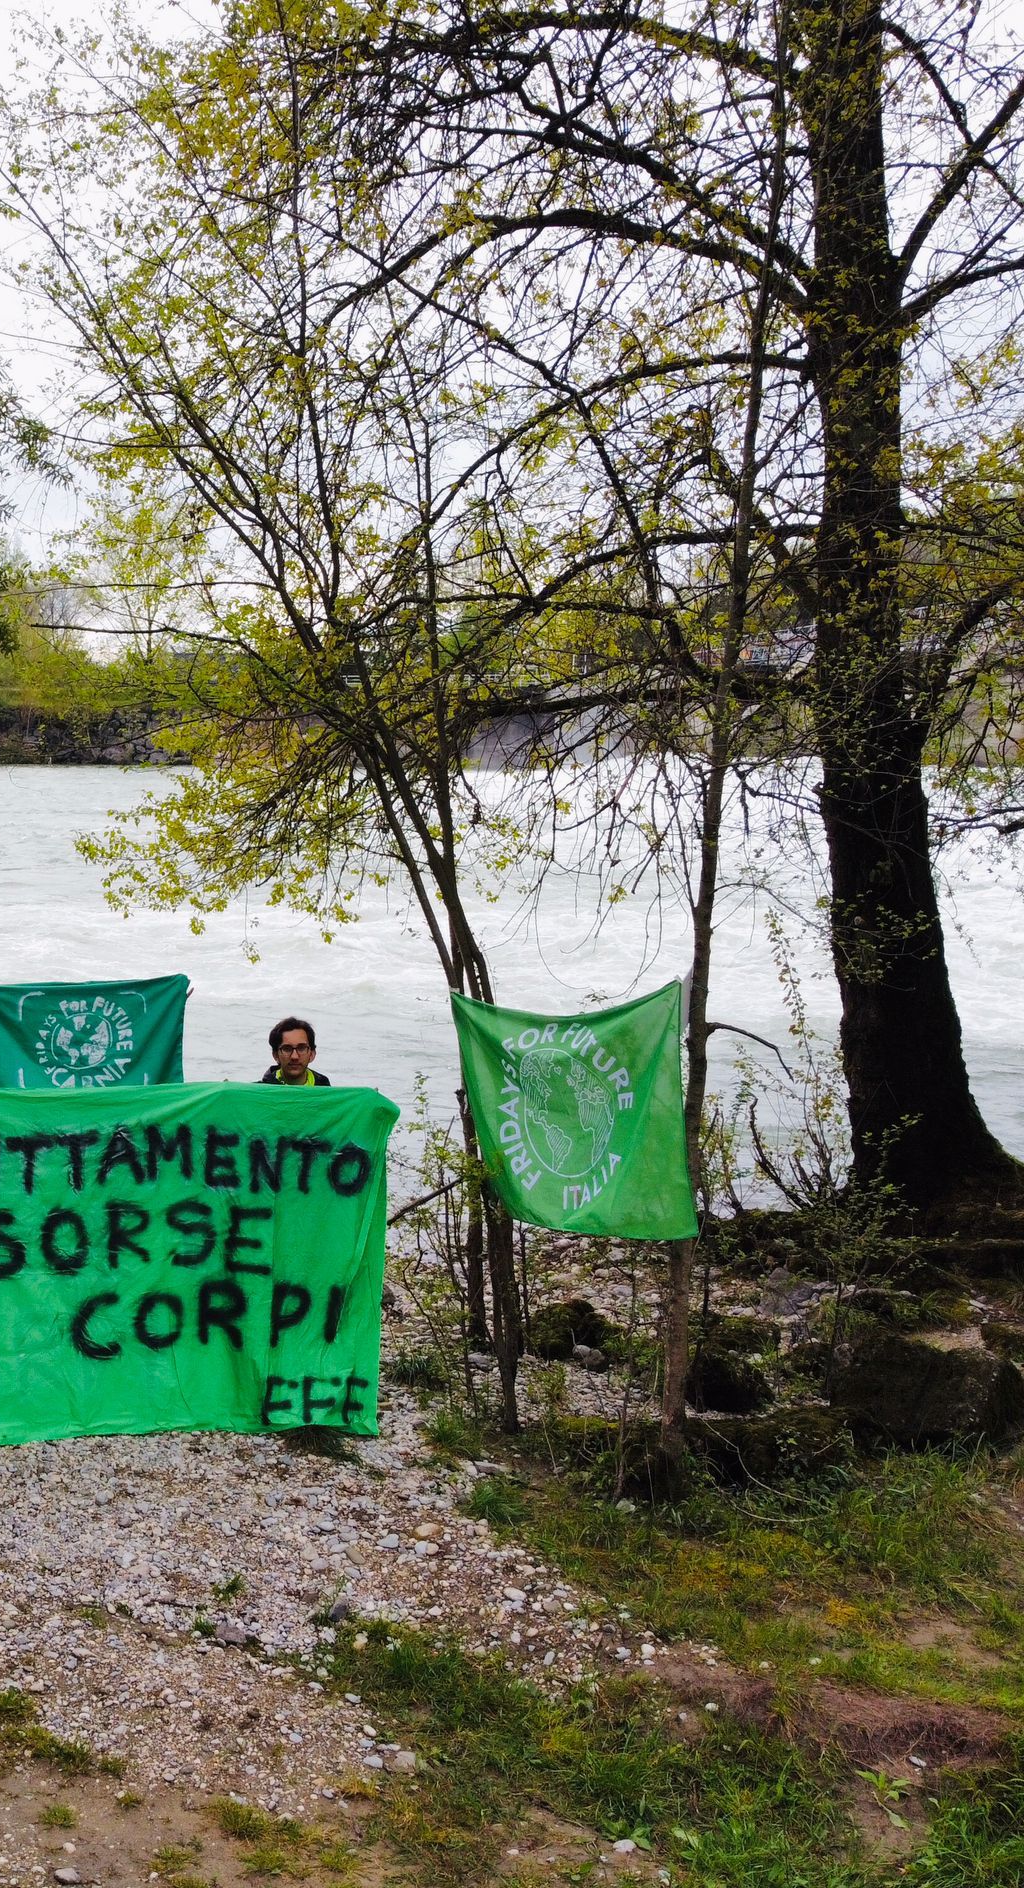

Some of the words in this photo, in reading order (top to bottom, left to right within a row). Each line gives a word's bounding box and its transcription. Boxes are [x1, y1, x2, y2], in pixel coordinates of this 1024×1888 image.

[35, 1014, 57, 1075] FRIDAYS
[59, 999, 88, 1017] FOR
[91, 996, 133, 1051] FUTURE
[502, 1022, 558, 1061] FOR
[560, 1022, 634, 1110] FUTURE
[498, 1058, 542, 1191] FRIDAYS
[562, 1152, 622, 1211] ITALIA
[71, 1278, 347, 1360] CORPI
[260, 1375, 369, 1426] FFF
